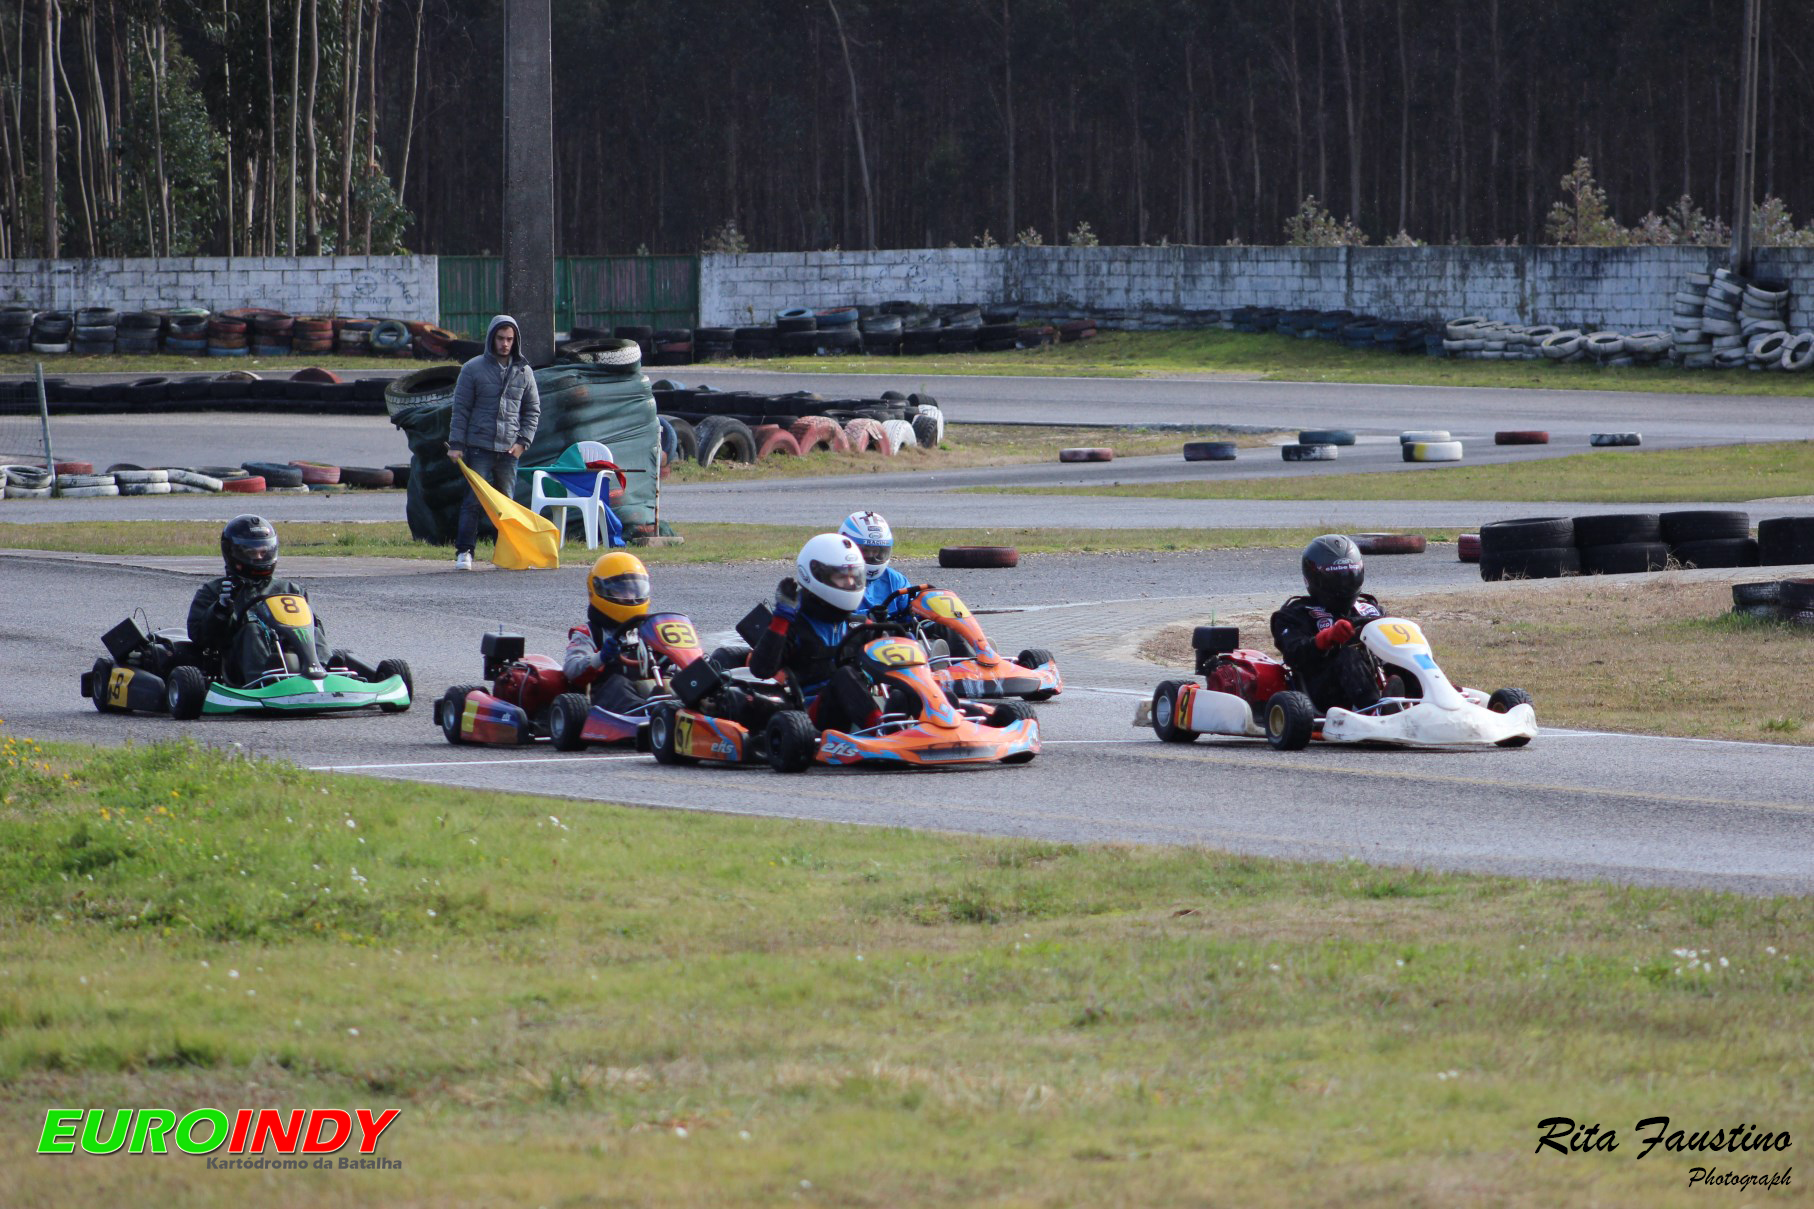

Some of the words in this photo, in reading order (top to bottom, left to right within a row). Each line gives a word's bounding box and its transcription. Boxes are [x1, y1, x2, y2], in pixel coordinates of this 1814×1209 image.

[281, 597, 299, 613] 8
[939, 597, 954, 613] 7
[661, 624, 696, 644] 63
[1392, 624, 1410, 642] 9
[882, 645, 915, 664] 67
[1181, 690, 1191, 725] 9
[677, 716, 693, 750] 67
